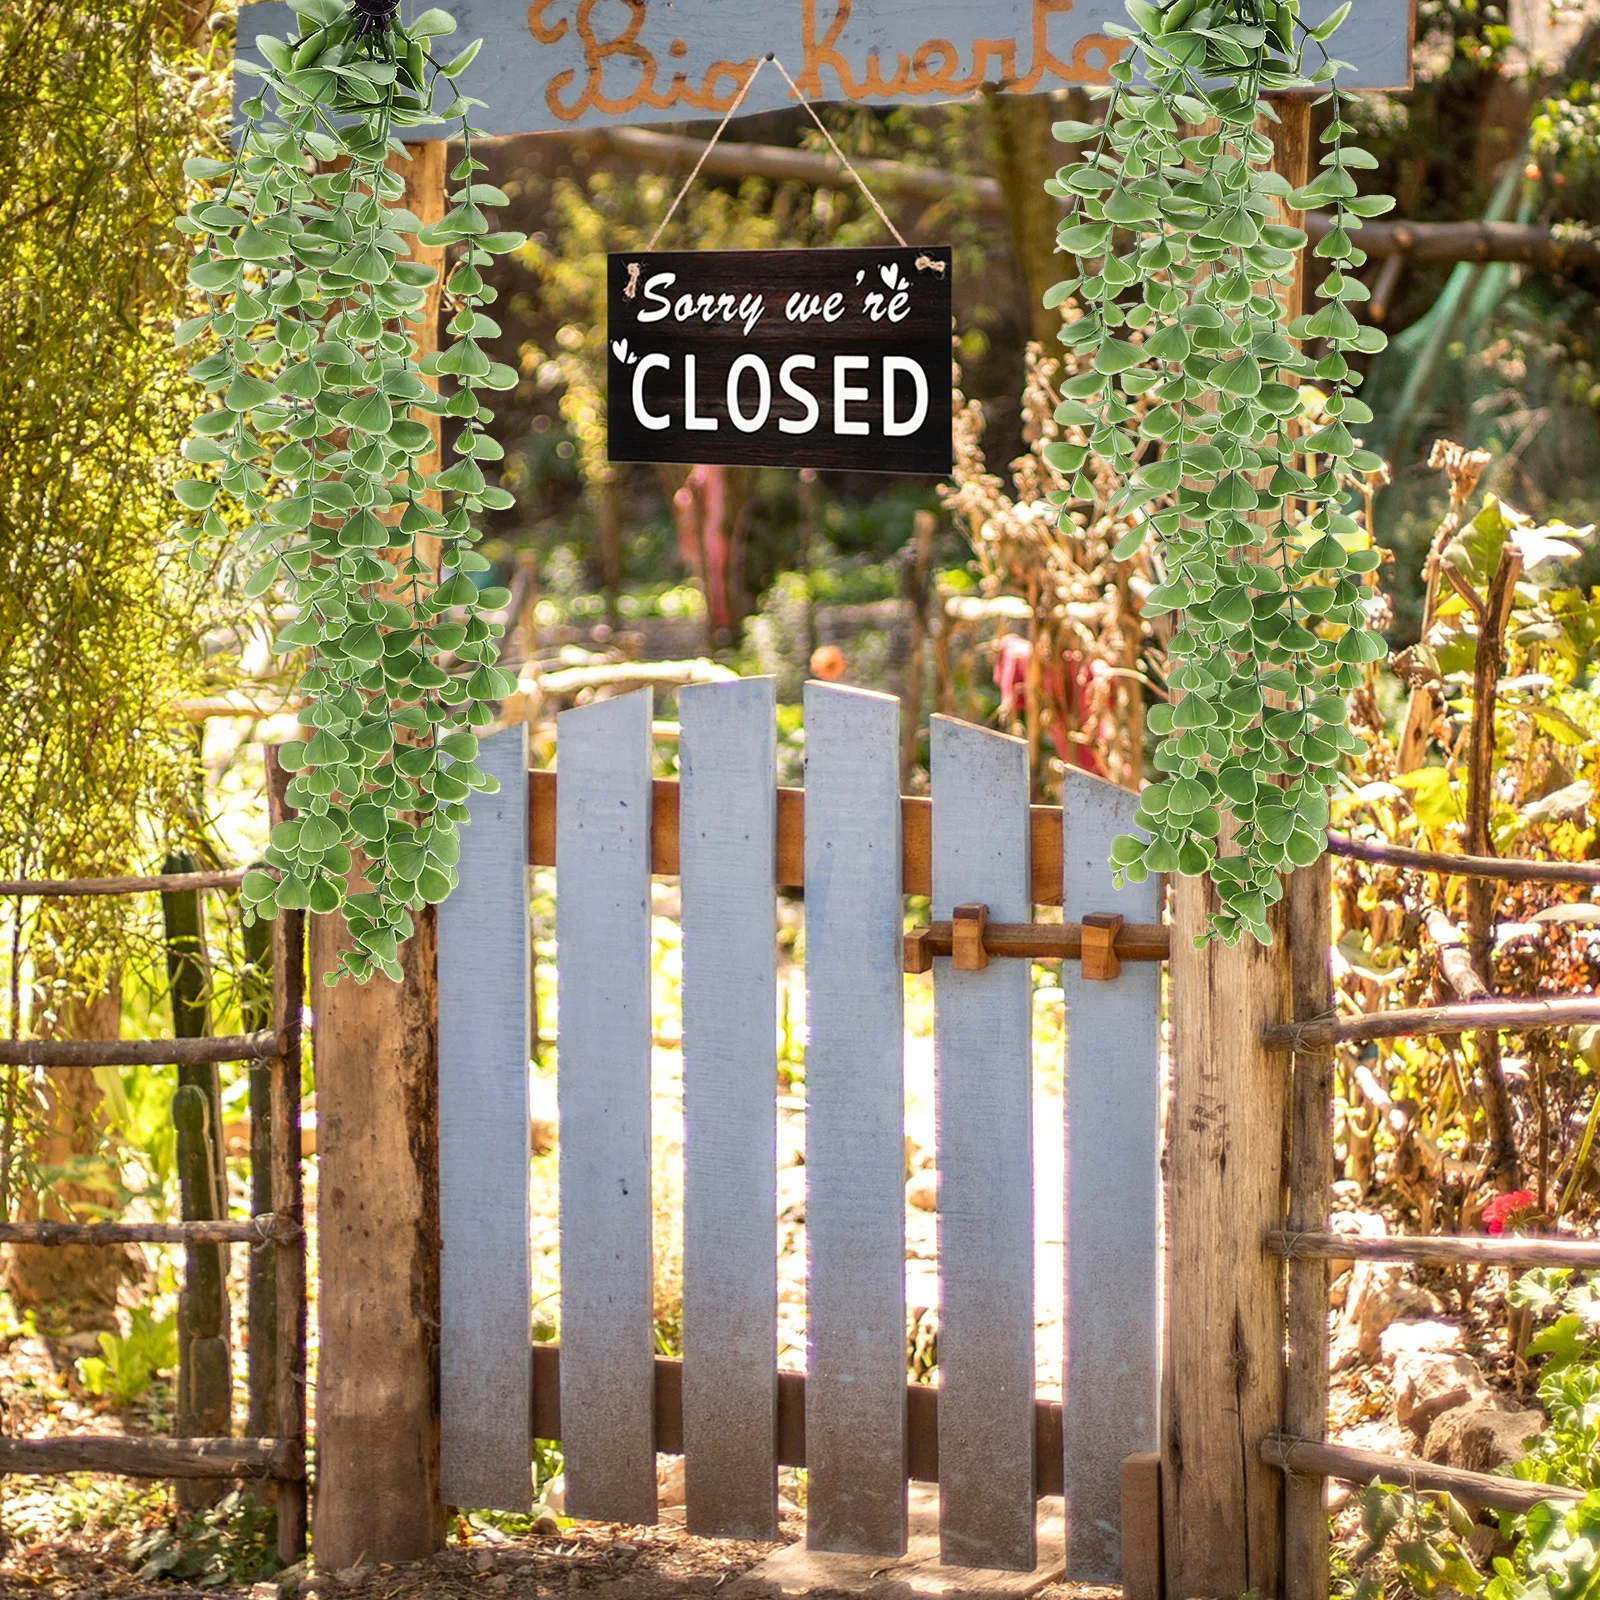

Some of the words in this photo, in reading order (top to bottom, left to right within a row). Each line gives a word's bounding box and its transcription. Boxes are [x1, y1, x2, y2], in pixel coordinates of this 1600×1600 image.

[528, 0, 757, 121] Bio
[637, 272, 765, 336] Sorry
[785, 269, 912, 323] we're
[632, 353, 929, 436] CLOSED
